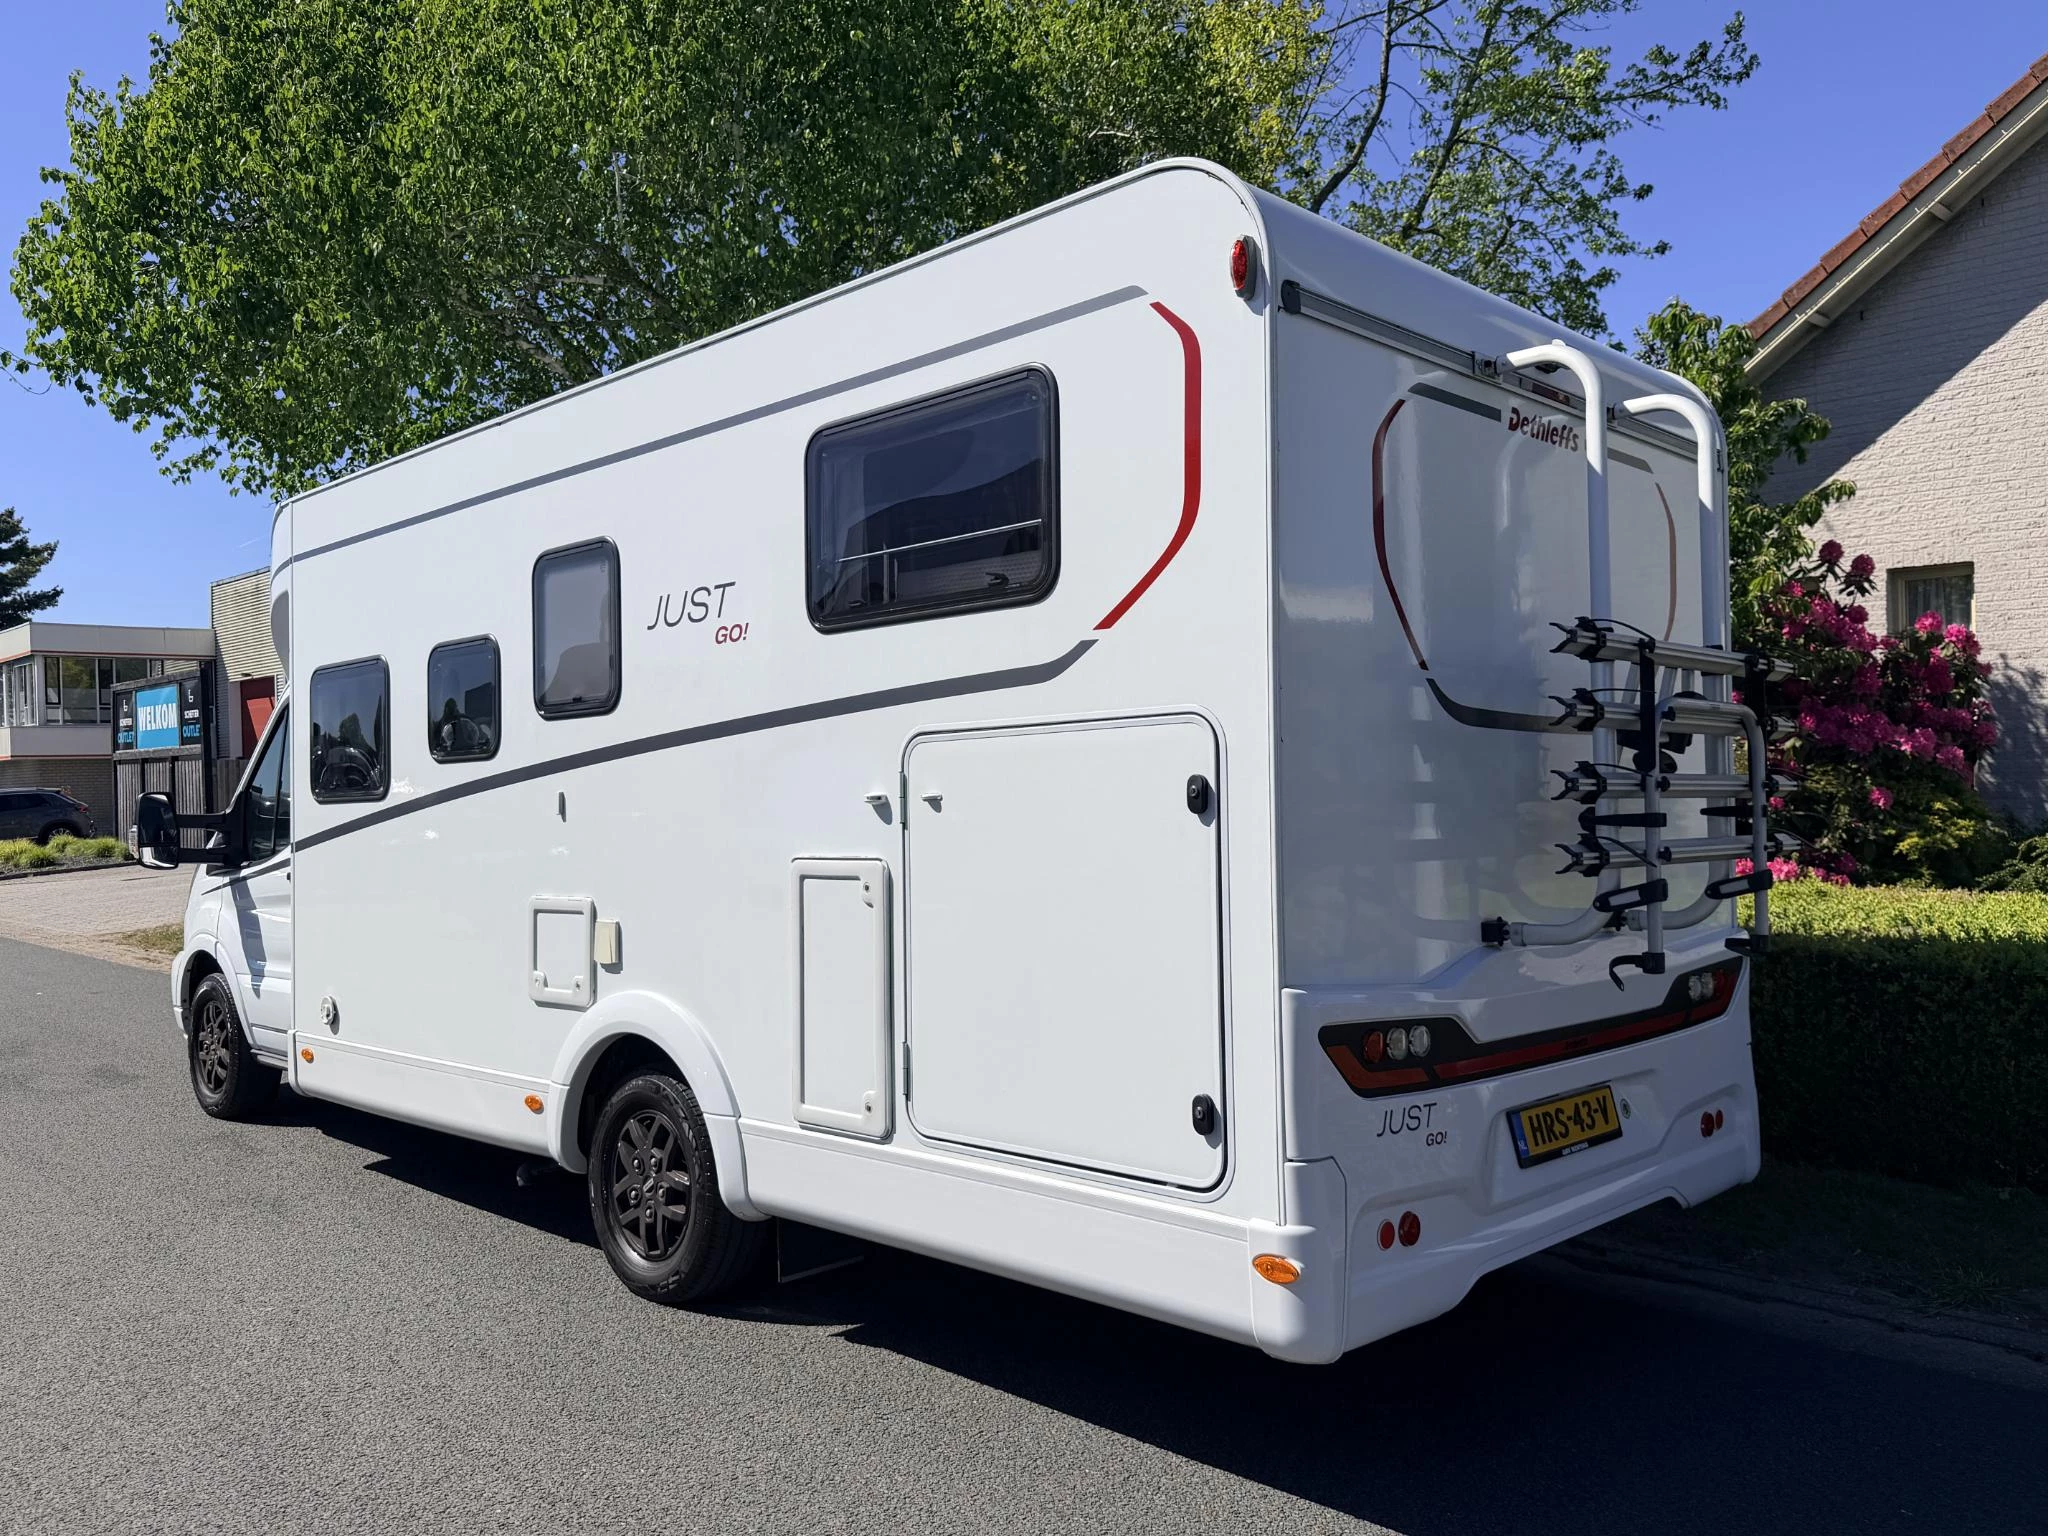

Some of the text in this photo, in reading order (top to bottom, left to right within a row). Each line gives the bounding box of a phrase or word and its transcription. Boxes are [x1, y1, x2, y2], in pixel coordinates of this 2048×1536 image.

[1508, 406, 1579, 452] Dethleffs
[647, 581, 736, 631] JUST
[715, 622, 749, 645] GO!
[138, 703, 177, 731] WELKOM
[182, 724, 200, 738] OUTLE
[1376, 1102, 1437, 1138] JUST
[1528, 1095, 1610, 1147] HRS-43-V
[1426, 1131, 1447, 1147] GO!
